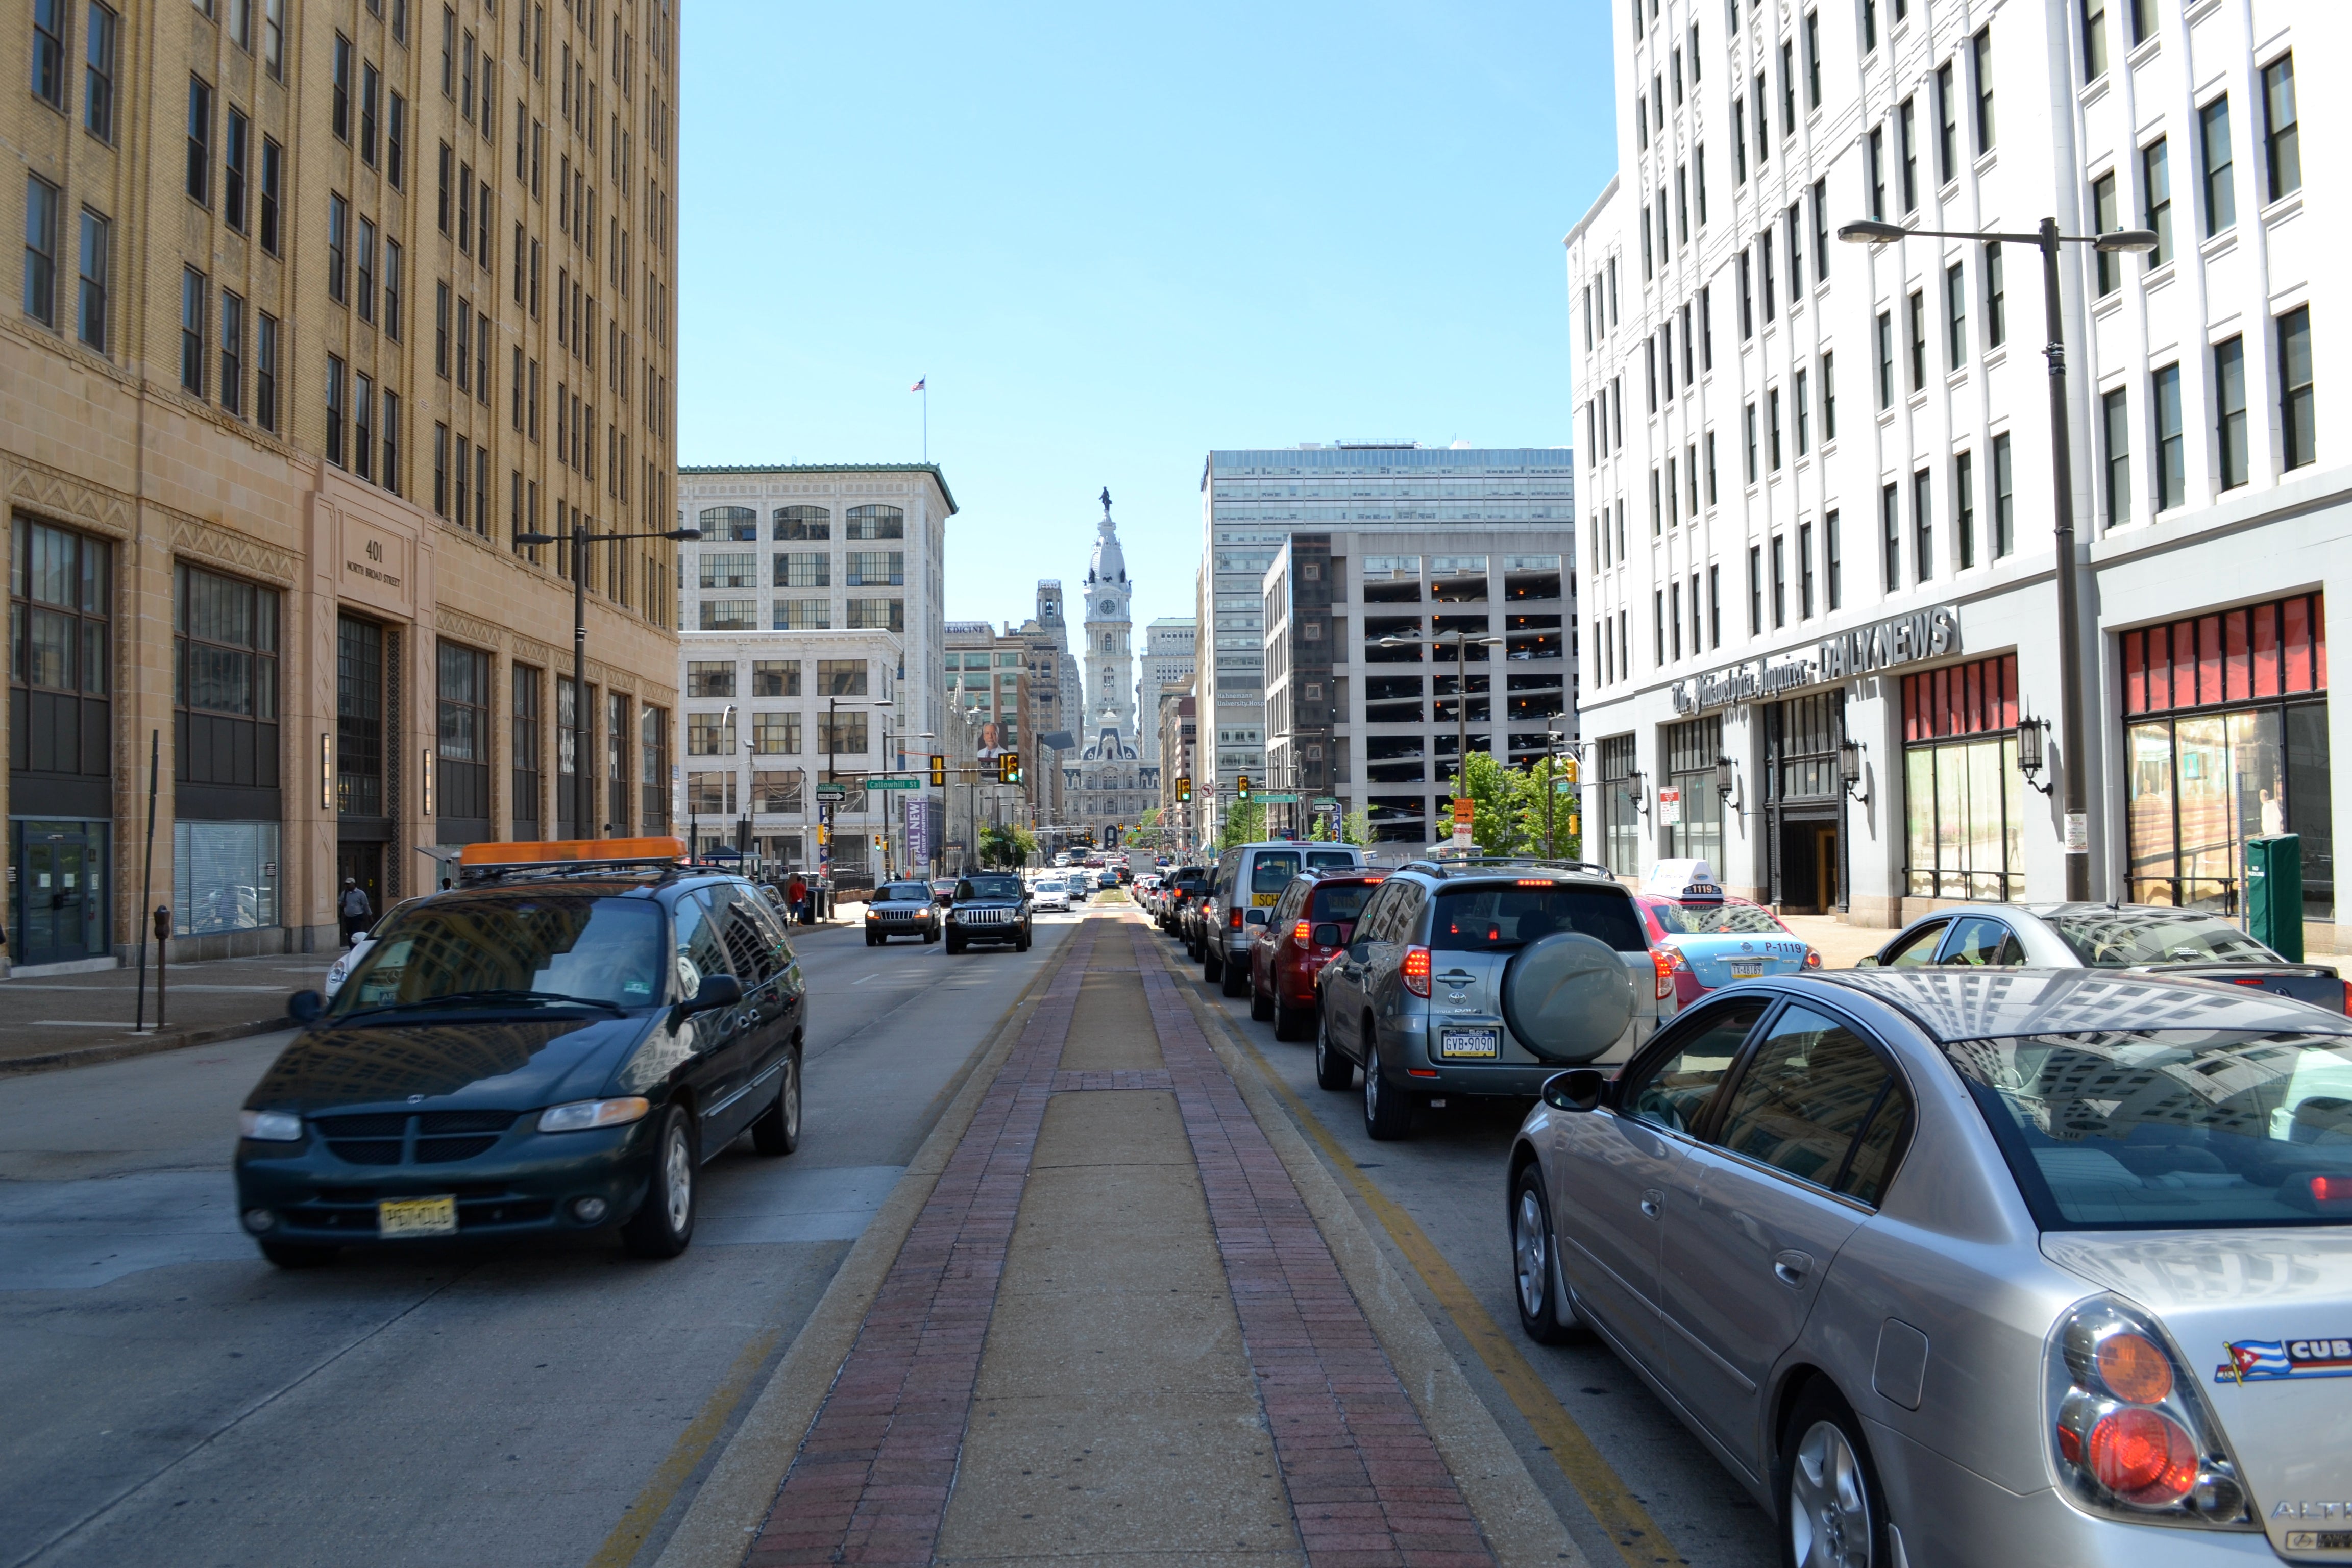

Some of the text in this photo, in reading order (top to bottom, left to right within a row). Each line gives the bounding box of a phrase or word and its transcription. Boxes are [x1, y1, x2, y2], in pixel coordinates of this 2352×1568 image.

[366, 540, 382, 563] 401
[347, 560, 400, 587] NORTH BROAD STREET
[1672, 606, 1952, 716] The Philadelphia Inquirer DAILY NEWS
[909, 803, 920, 854] ALL NEW
[1692, 885, 1712, 893] 1119
[1765, 942, 1802, 953] P-1119
